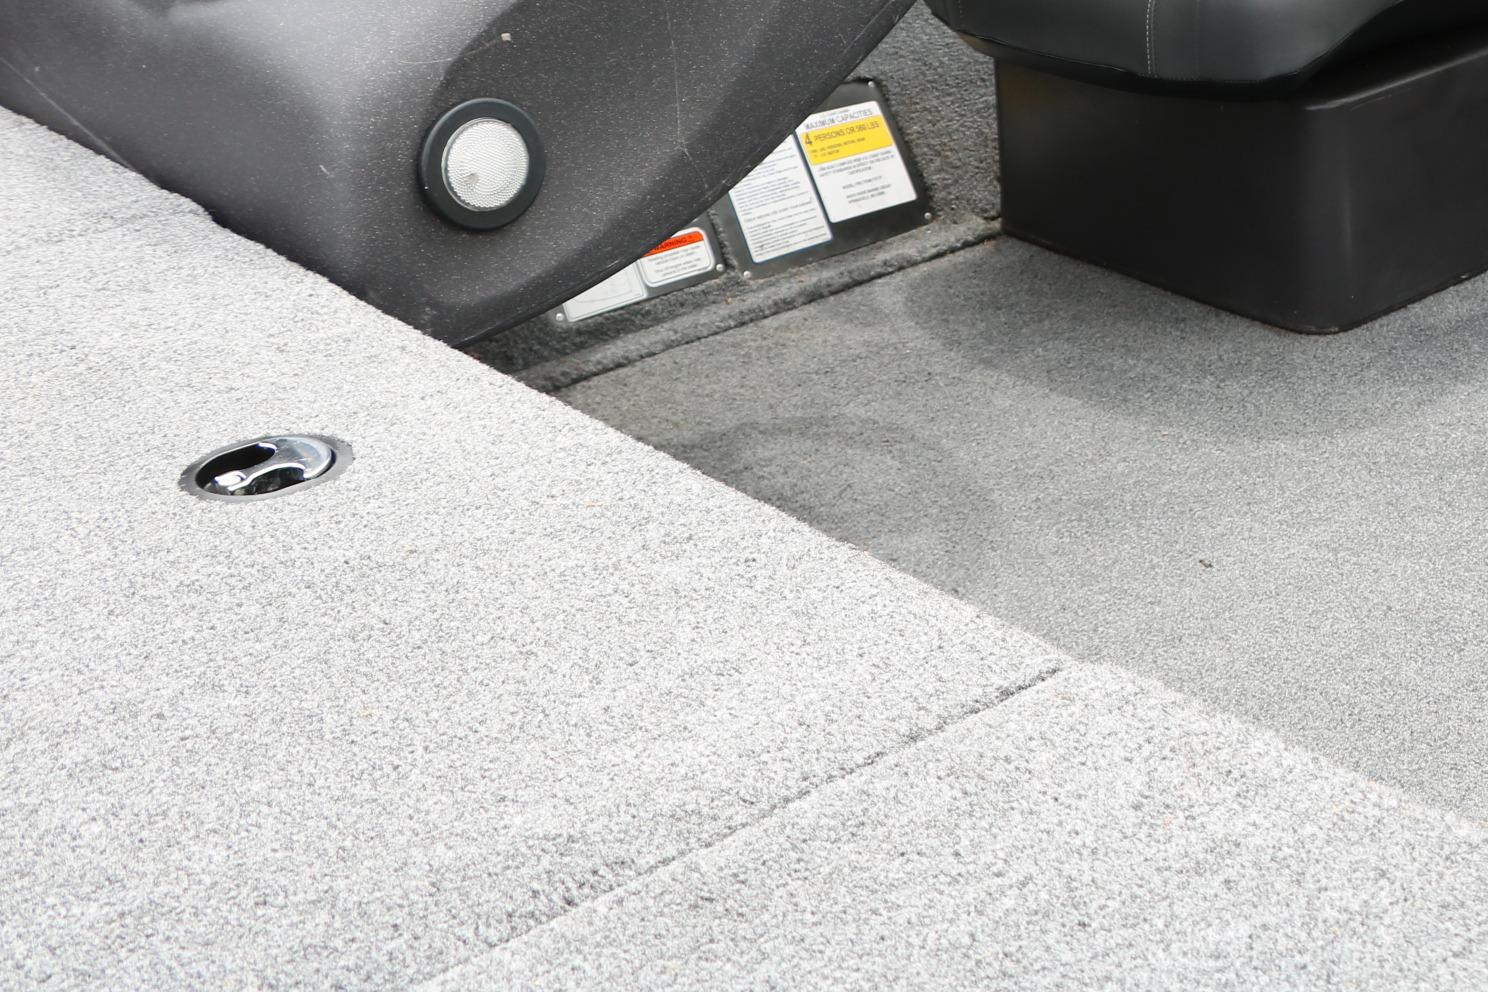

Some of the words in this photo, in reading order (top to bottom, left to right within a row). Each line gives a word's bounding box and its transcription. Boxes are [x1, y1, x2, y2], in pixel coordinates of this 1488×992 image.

[804, 117, 835, 129] MAXIMUM
[836, 109, 873, 122] CAPACITIES
[805, 133, 812, 145] 4
[814, 129, 845, 141] PERSONS
[846, 127, 855, 135] OR
